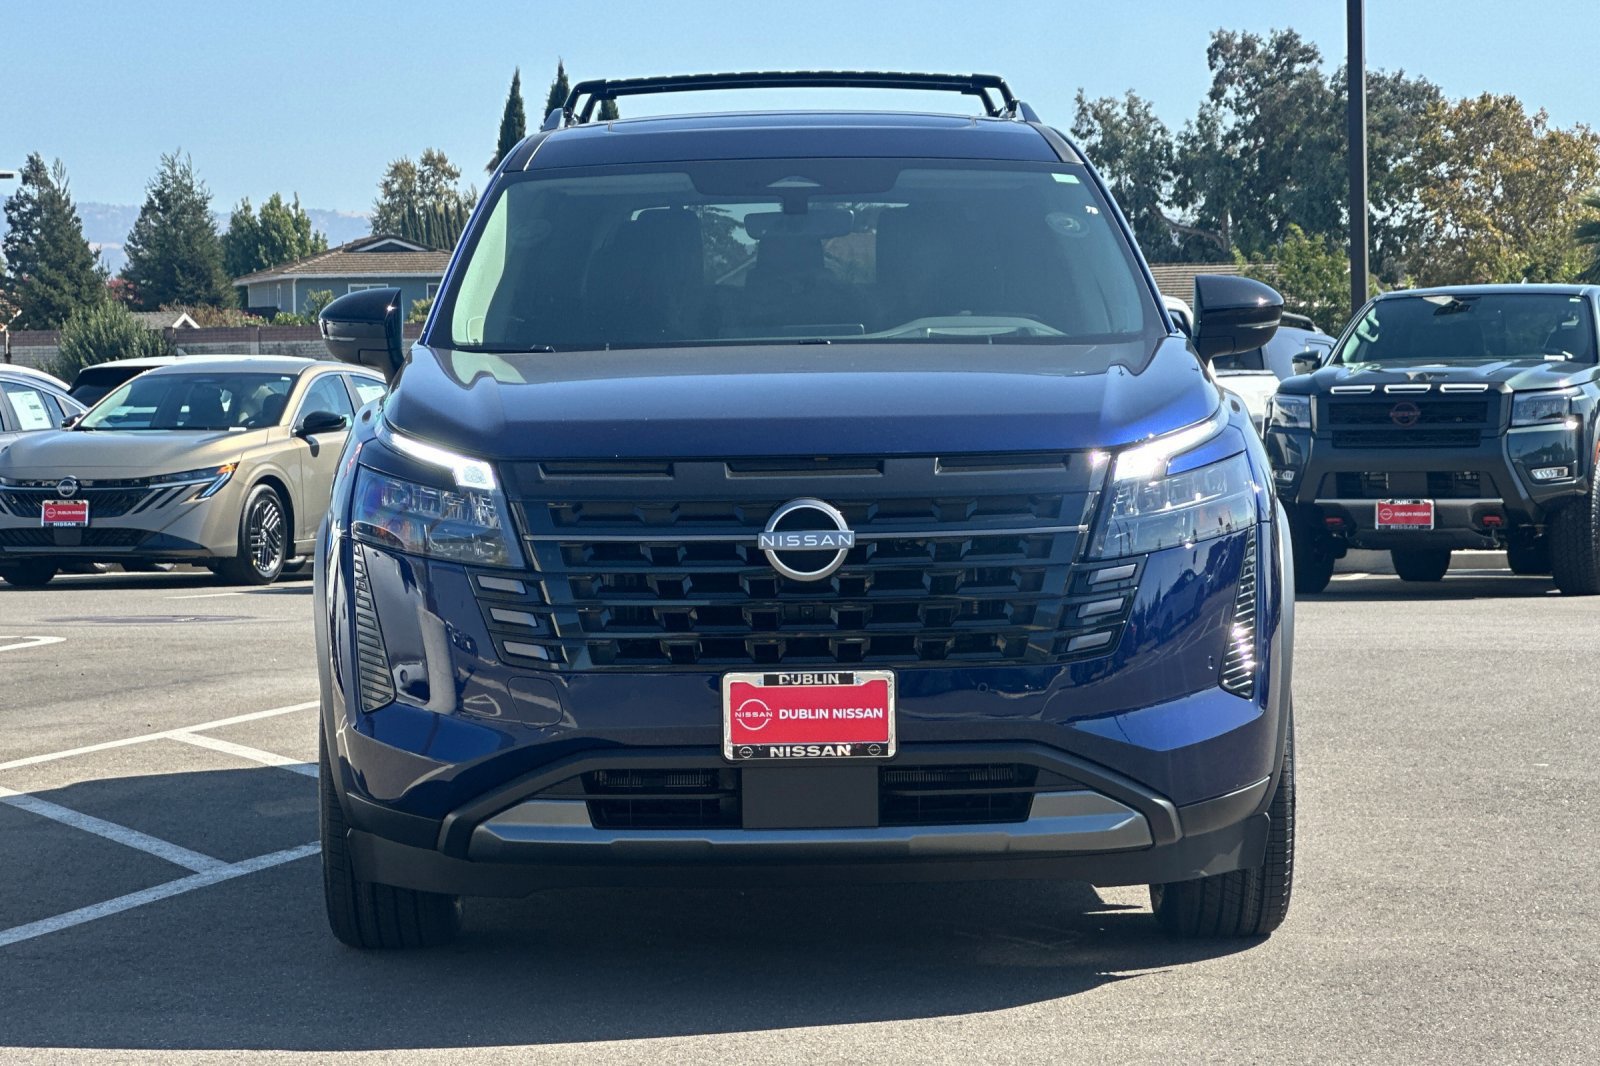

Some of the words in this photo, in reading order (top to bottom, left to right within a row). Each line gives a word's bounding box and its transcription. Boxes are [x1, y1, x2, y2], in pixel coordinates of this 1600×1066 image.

[760, 534, 852, 547] NISSAN
[778, 674, 840, 685] DUBLIN
[778, 708, 829, 720] DUBLIN
[832, 708, 883, 718] NISSAN
[770, 744, 851, 758] NISSAN
